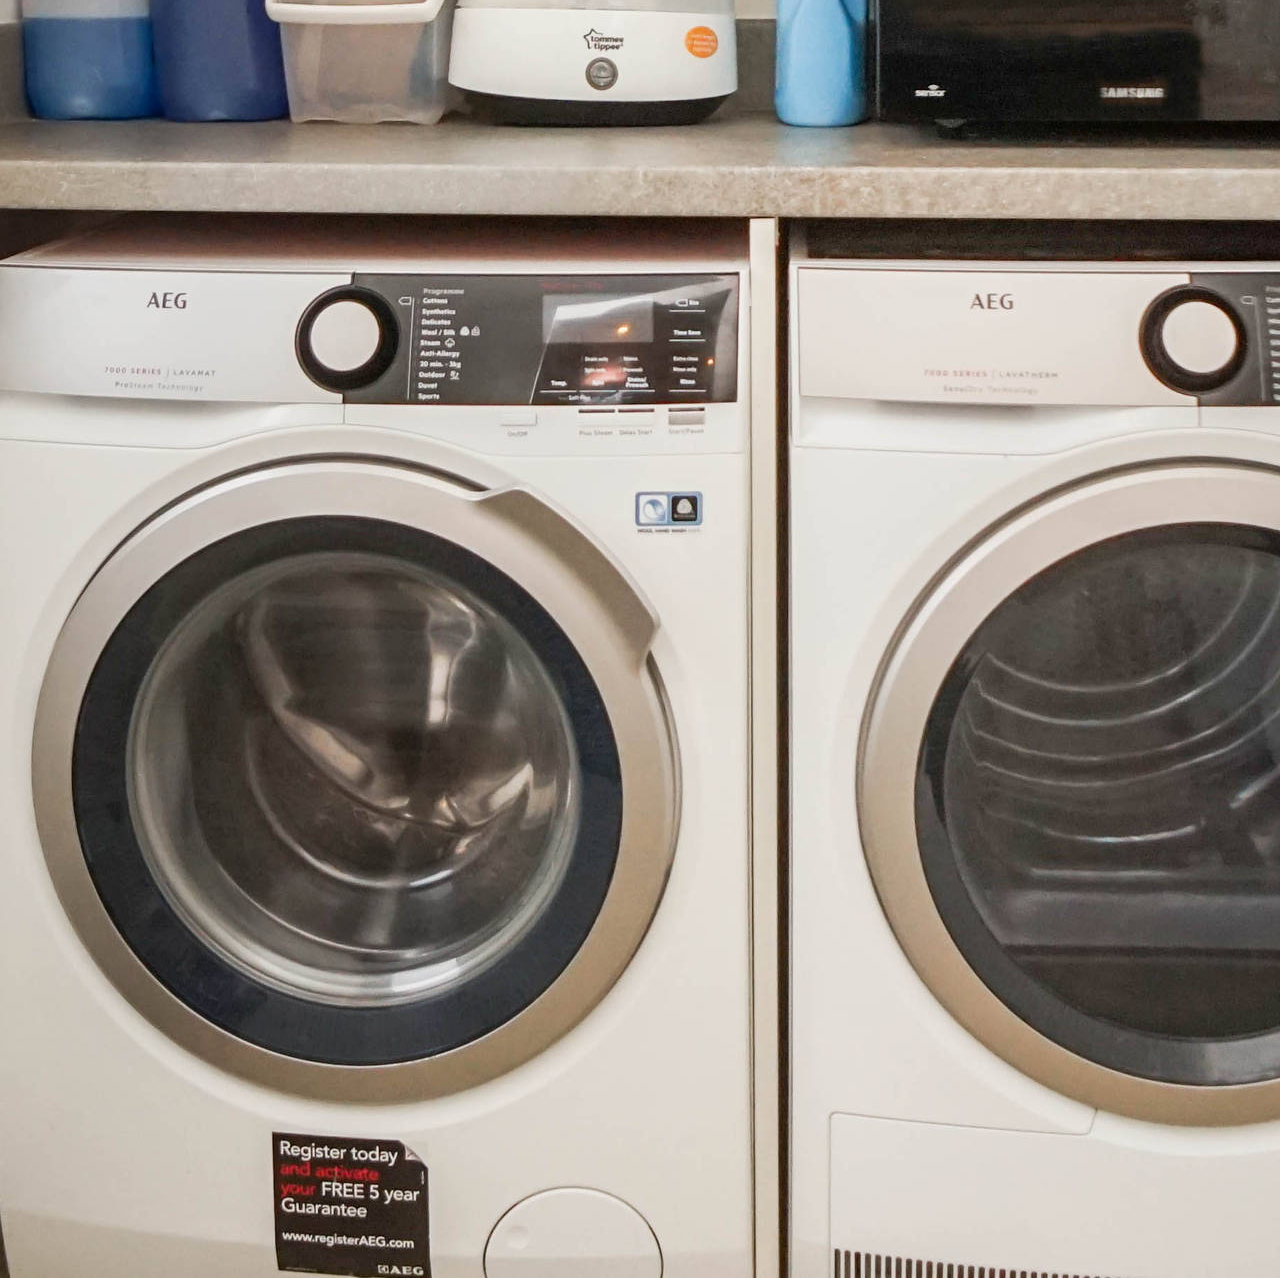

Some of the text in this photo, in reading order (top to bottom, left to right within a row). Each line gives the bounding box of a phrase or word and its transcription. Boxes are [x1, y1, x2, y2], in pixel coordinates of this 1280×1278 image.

[915, 89, 946, 97] sensor
[1099, 87, 1164, 98] SAMSUNG
[146, 292, 187, 309] AEG
[970, 293, 1014, 310] AEG
[422, 308, 456, 316] Synthetics
[420, 350, 460, 358] Anti-Allergy
[104, 366, 217, 377] 7000 SERIES LAVAMAT
[952, 369, 988, 378] SERIES
[280, 1140, 398, 1166] Register today
[280, 1162, 380, 1181] and activate
[281, 1181, 420, 1204] your FREE 5 year
[281, 1197, 368, 1217] Guarantee
[282, 1231, 415, 1248] www.registerAEG.com
[390, 1265, 424, 1276] AEG
